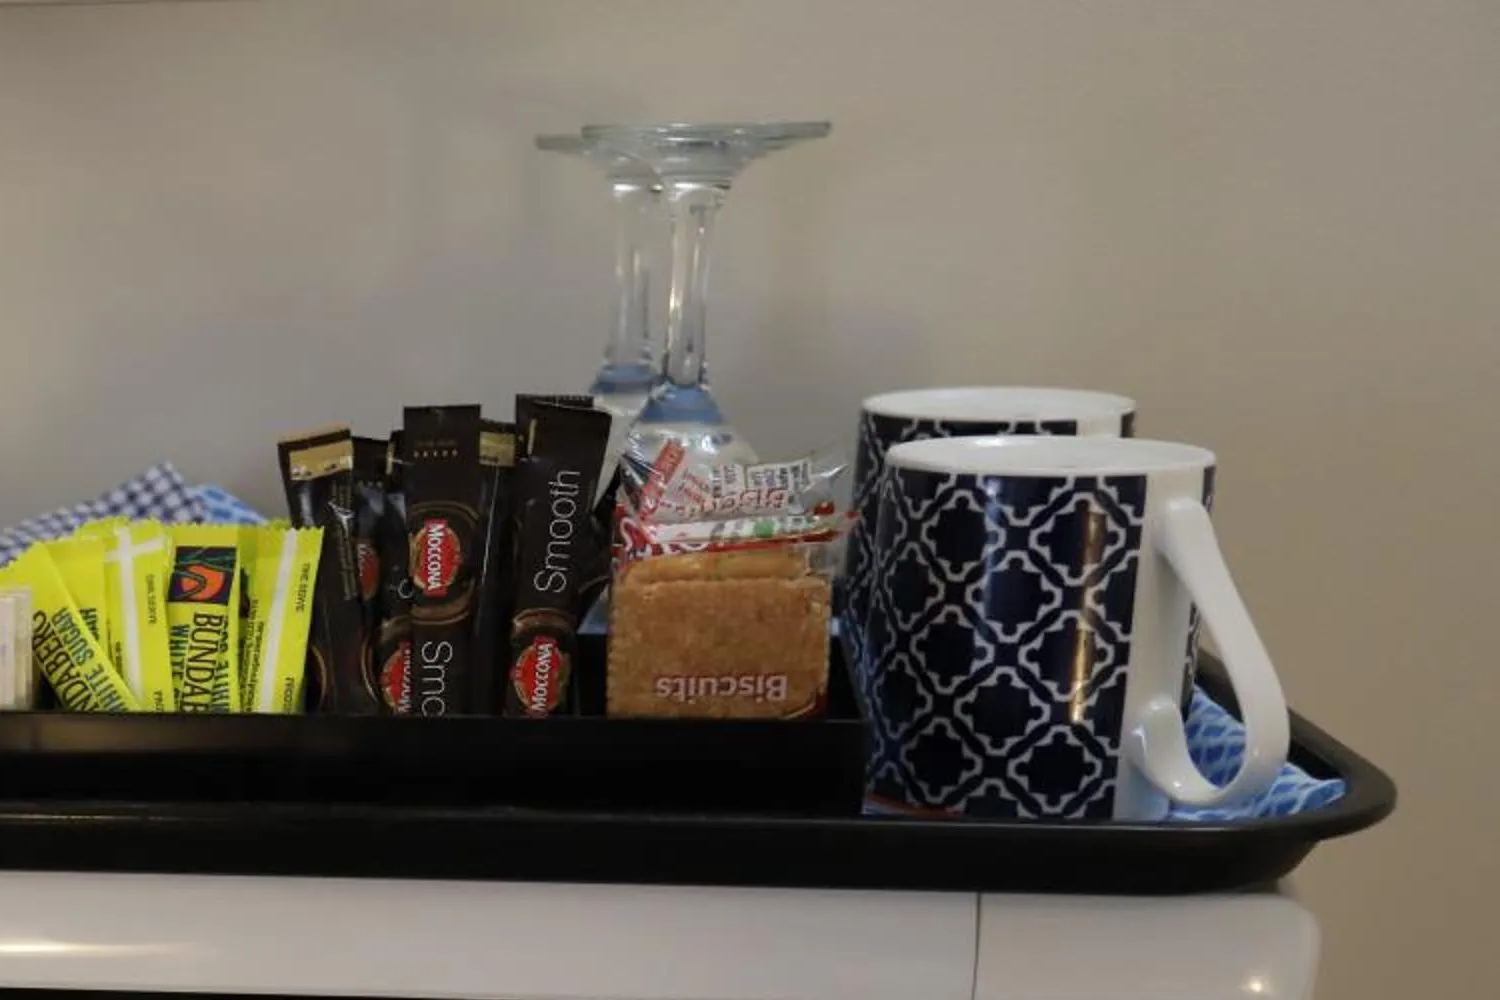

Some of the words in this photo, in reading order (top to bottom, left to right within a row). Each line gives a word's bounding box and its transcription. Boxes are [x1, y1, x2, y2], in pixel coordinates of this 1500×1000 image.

[533, 470, 581, 594] Smooth
[51, 607, 95, 665] SUGAR
[655, 674, 790, 705] Biscuits
